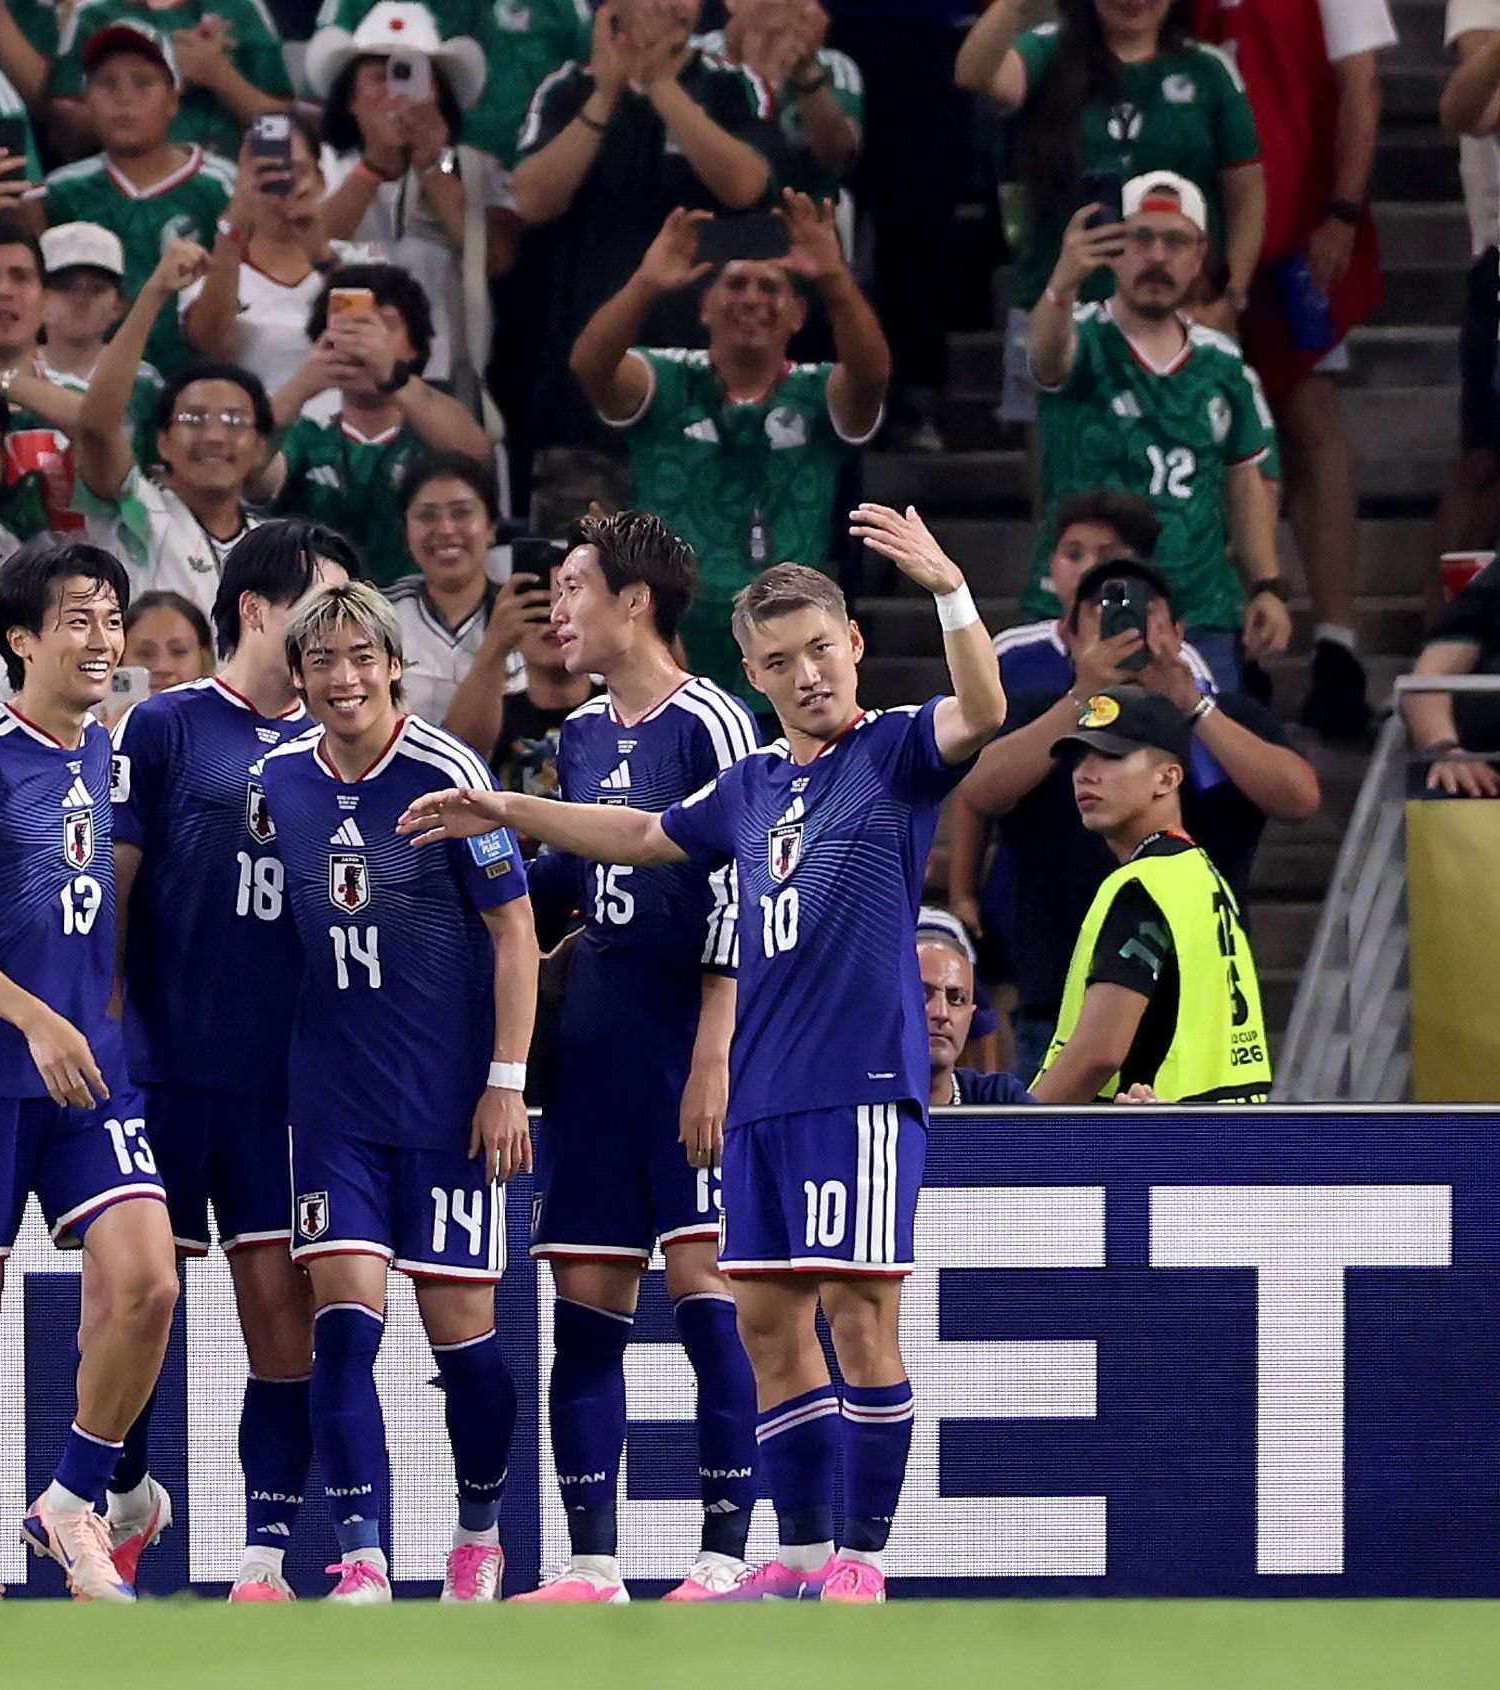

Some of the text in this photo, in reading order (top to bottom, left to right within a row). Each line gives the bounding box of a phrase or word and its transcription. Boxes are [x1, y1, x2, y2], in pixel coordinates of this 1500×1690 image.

[1146, 444, 1197, 498] 12
[60, 875, 103, 935] 13
[235, 851, 285, 921] 18
[594, 863, 635, 925] 15
[760, 887, 799, 958] 10
[329, 925, 382, 990] 14
[103, 1118, 157, 1175] 13
[430, 1186, 483, 1256] 14
[804, 1180, 847, 1248] 10
[557, 1471, 606, 1485] APAN
